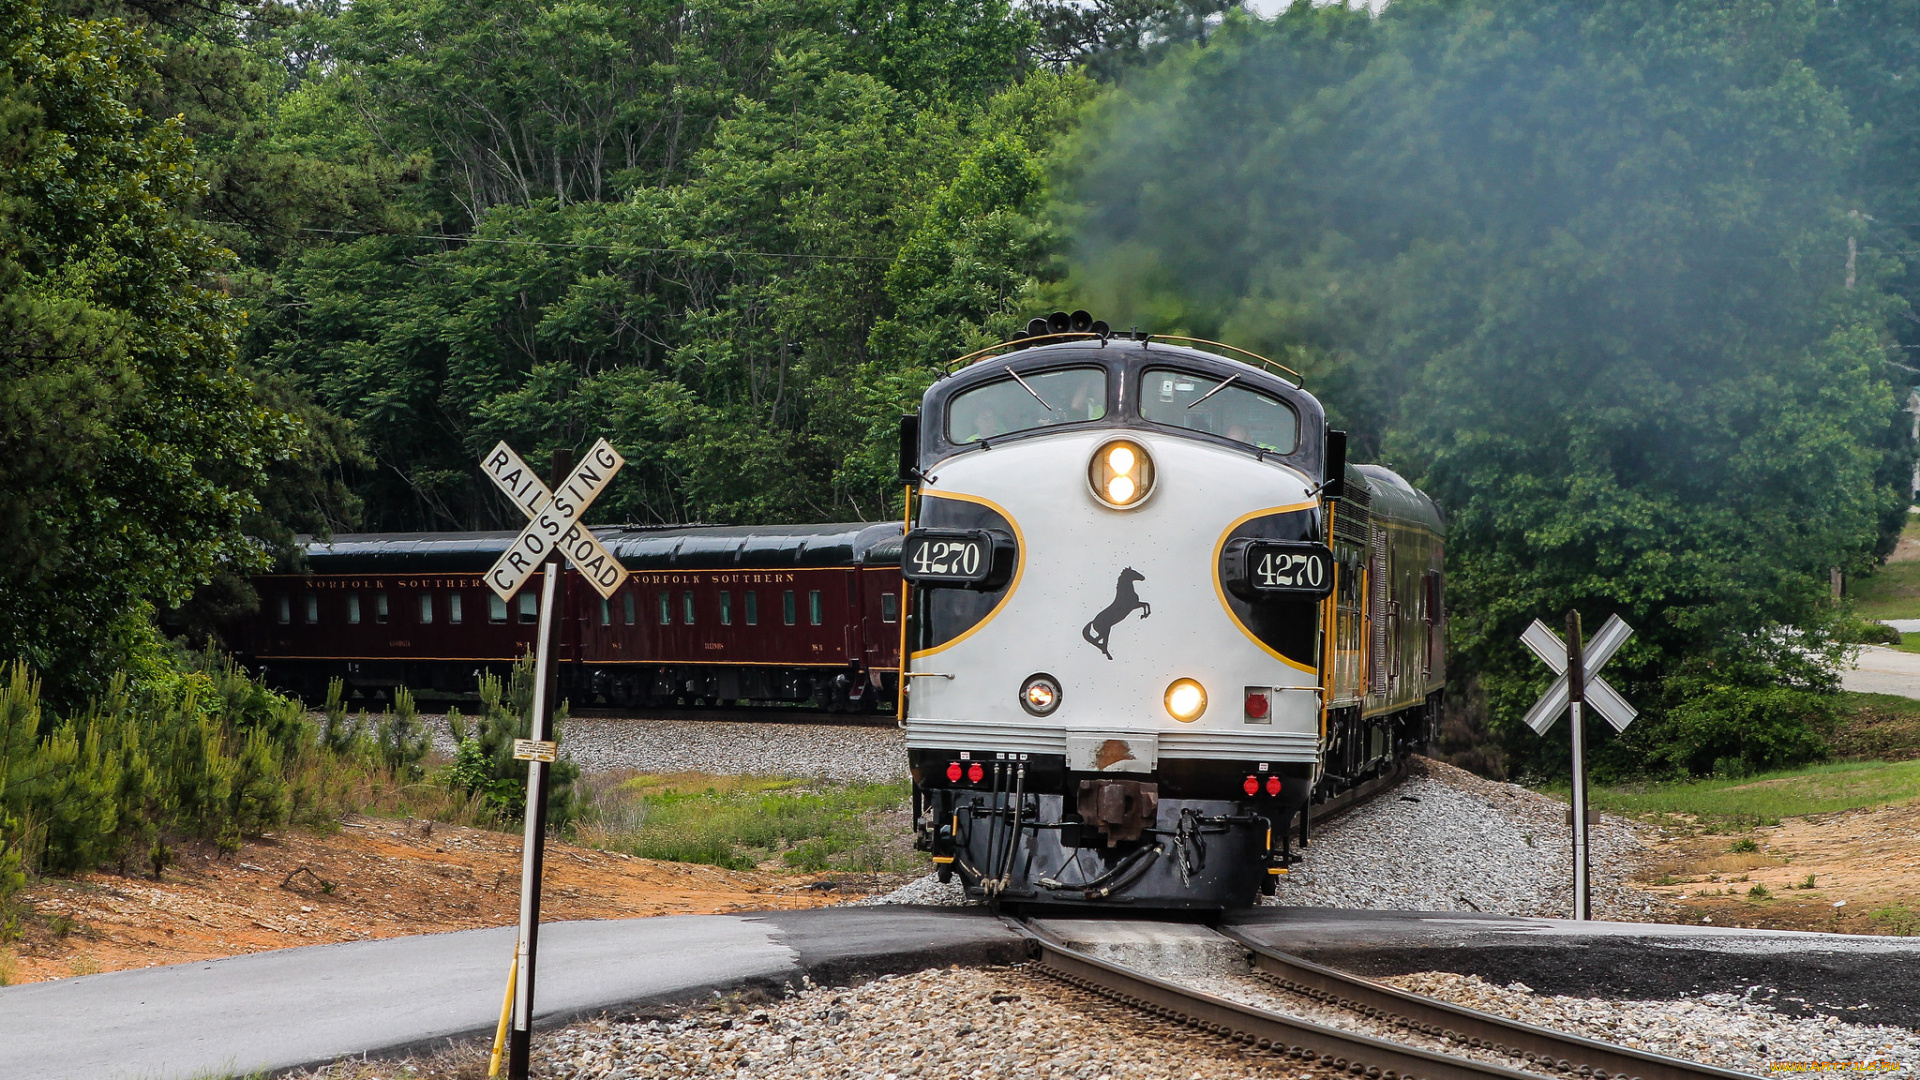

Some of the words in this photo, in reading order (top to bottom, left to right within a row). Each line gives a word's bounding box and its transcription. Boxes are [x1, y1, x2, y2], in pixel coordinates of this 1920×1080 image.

[488, 449, 543, 516] RAIL
[558, 525, 619, 588] ROAD
[493, 448, 616, 591] CROSSING
[912, 541, 980, 576] 4270
[1256, 553, 1324, 587] 4270
[305, 580, 385, 589] NORFOLK
[397, 578, 490, 588] SOUTHER
[633, 574, 701, 584] NORFOLK
[711, 573, 795, 584] SOUTHERN
